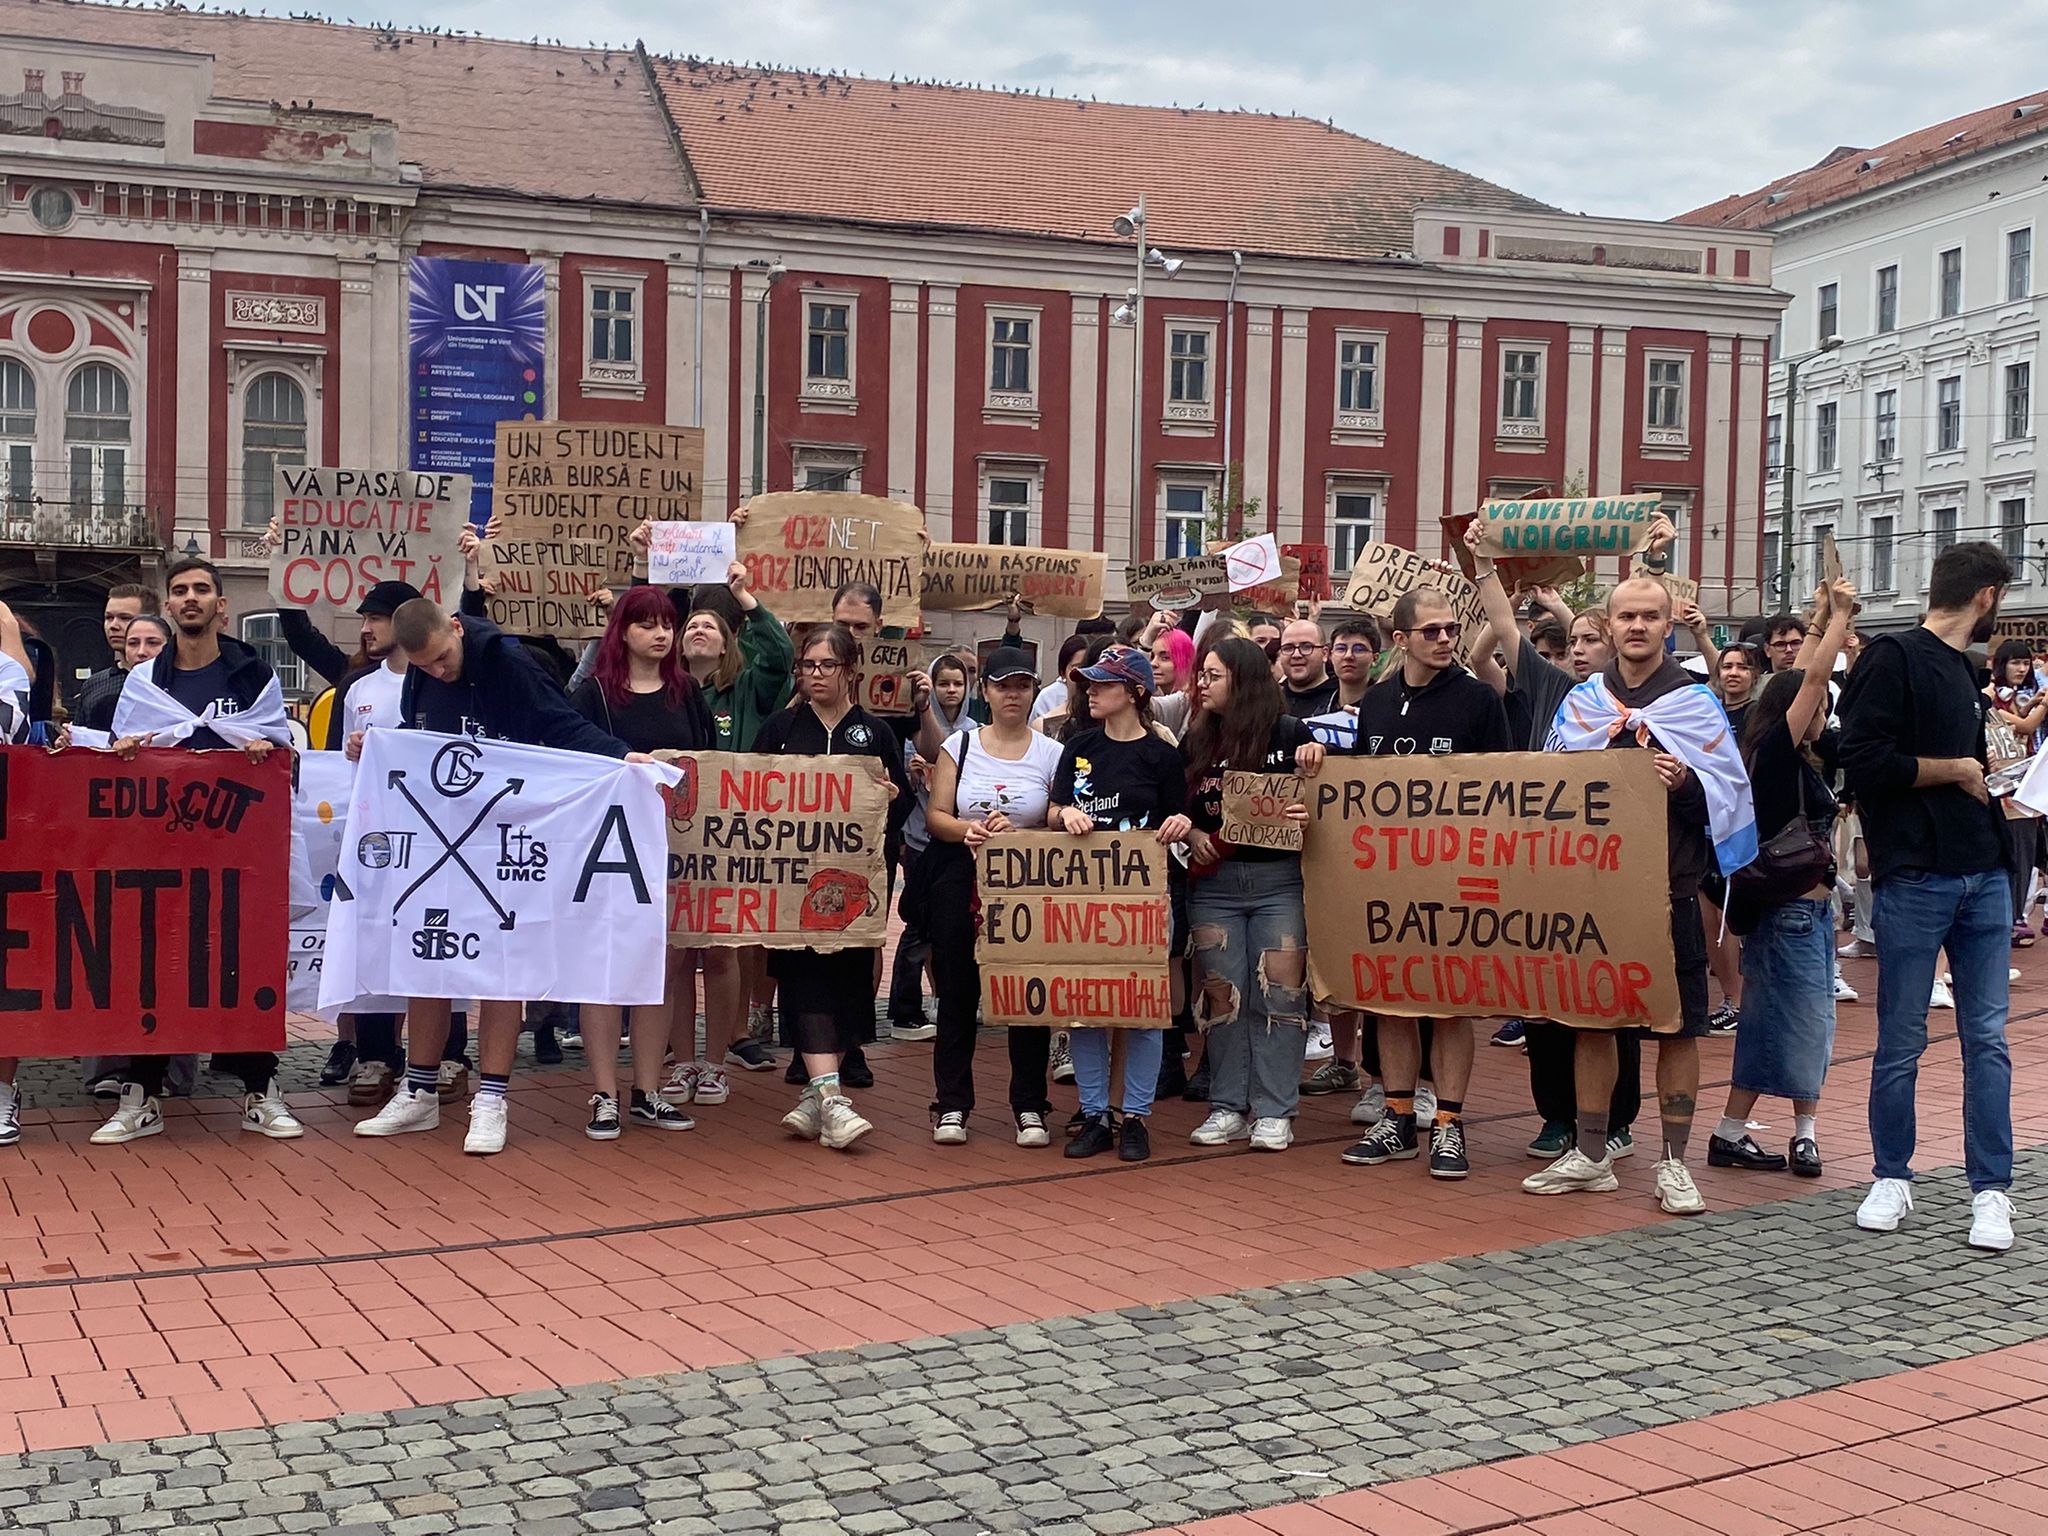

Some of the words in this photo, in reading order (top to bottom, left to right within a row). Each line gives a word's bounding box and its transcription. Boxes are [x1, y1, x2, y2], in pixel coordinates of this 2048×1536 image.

[507, 431, 541, 459] UN
[556, 429, 685, 461] STUDENT
[282, 468, 323, 496] VĂ
[336, 471, 401, 498] PASĂ
[415, 474, 453, 501] DE
[507, 462, 551, 488] FĂRĂ
[567, 465, 630, 488] BURSĂ
[640, 468, 652, 489] E
[660, 469, 692, 493] UN
[283, 499, 433, 535] EDUCAȚIE
[504, 493, 602, 518] STUDENT
[616, 497, 648, 520] CU
[657, 498, 689, 521] UN
[1488, 502, 1523, 521] VOI
[1591, 500, 1661, 522] BUGET
[283, 528, 357, 556] PÂNĂ
[377, 530, 408, 558] VĂ
[828, 516, 884, 551] NET
[1502, 525, 1549, 549] NOI
[1555, 524, 1631, 551] GRIJI
[493, 543, 606, 567] DREPTURILE
[653, 555, 669, 567] NU
[923, 550, 989, 570] NICIUN
[500, 571, 532, 593] NU
[547, 570, 600, 596] SUNT
[964, 573, 1020, 595] MULTE
[1377, 566, 1414, 592] NU
[492, 597, 606, 632] OPȚIONALE
[870, 645, 908, 668] GREA
[719, 769, 853, 814] NICIUN
[1226, 775, 1257, 796] 10%
[1261, 776, 1306, 799] NET
[1316, 779, 1611, 826] PROBLEMELE
[496, 868, 547, 883] UMC
[668, 853, 718, 882] DAR
[727, 856, 810, 885] MULTE
[986, 840, 1150, 892] EDUCAȚIA
[1012, 903, 1032, 943] O
[1366, 900, 1609, 955] BATJOCURA
[990, 974, 1026, 1017] NU
[1026, 977, 1047, 1016] O
